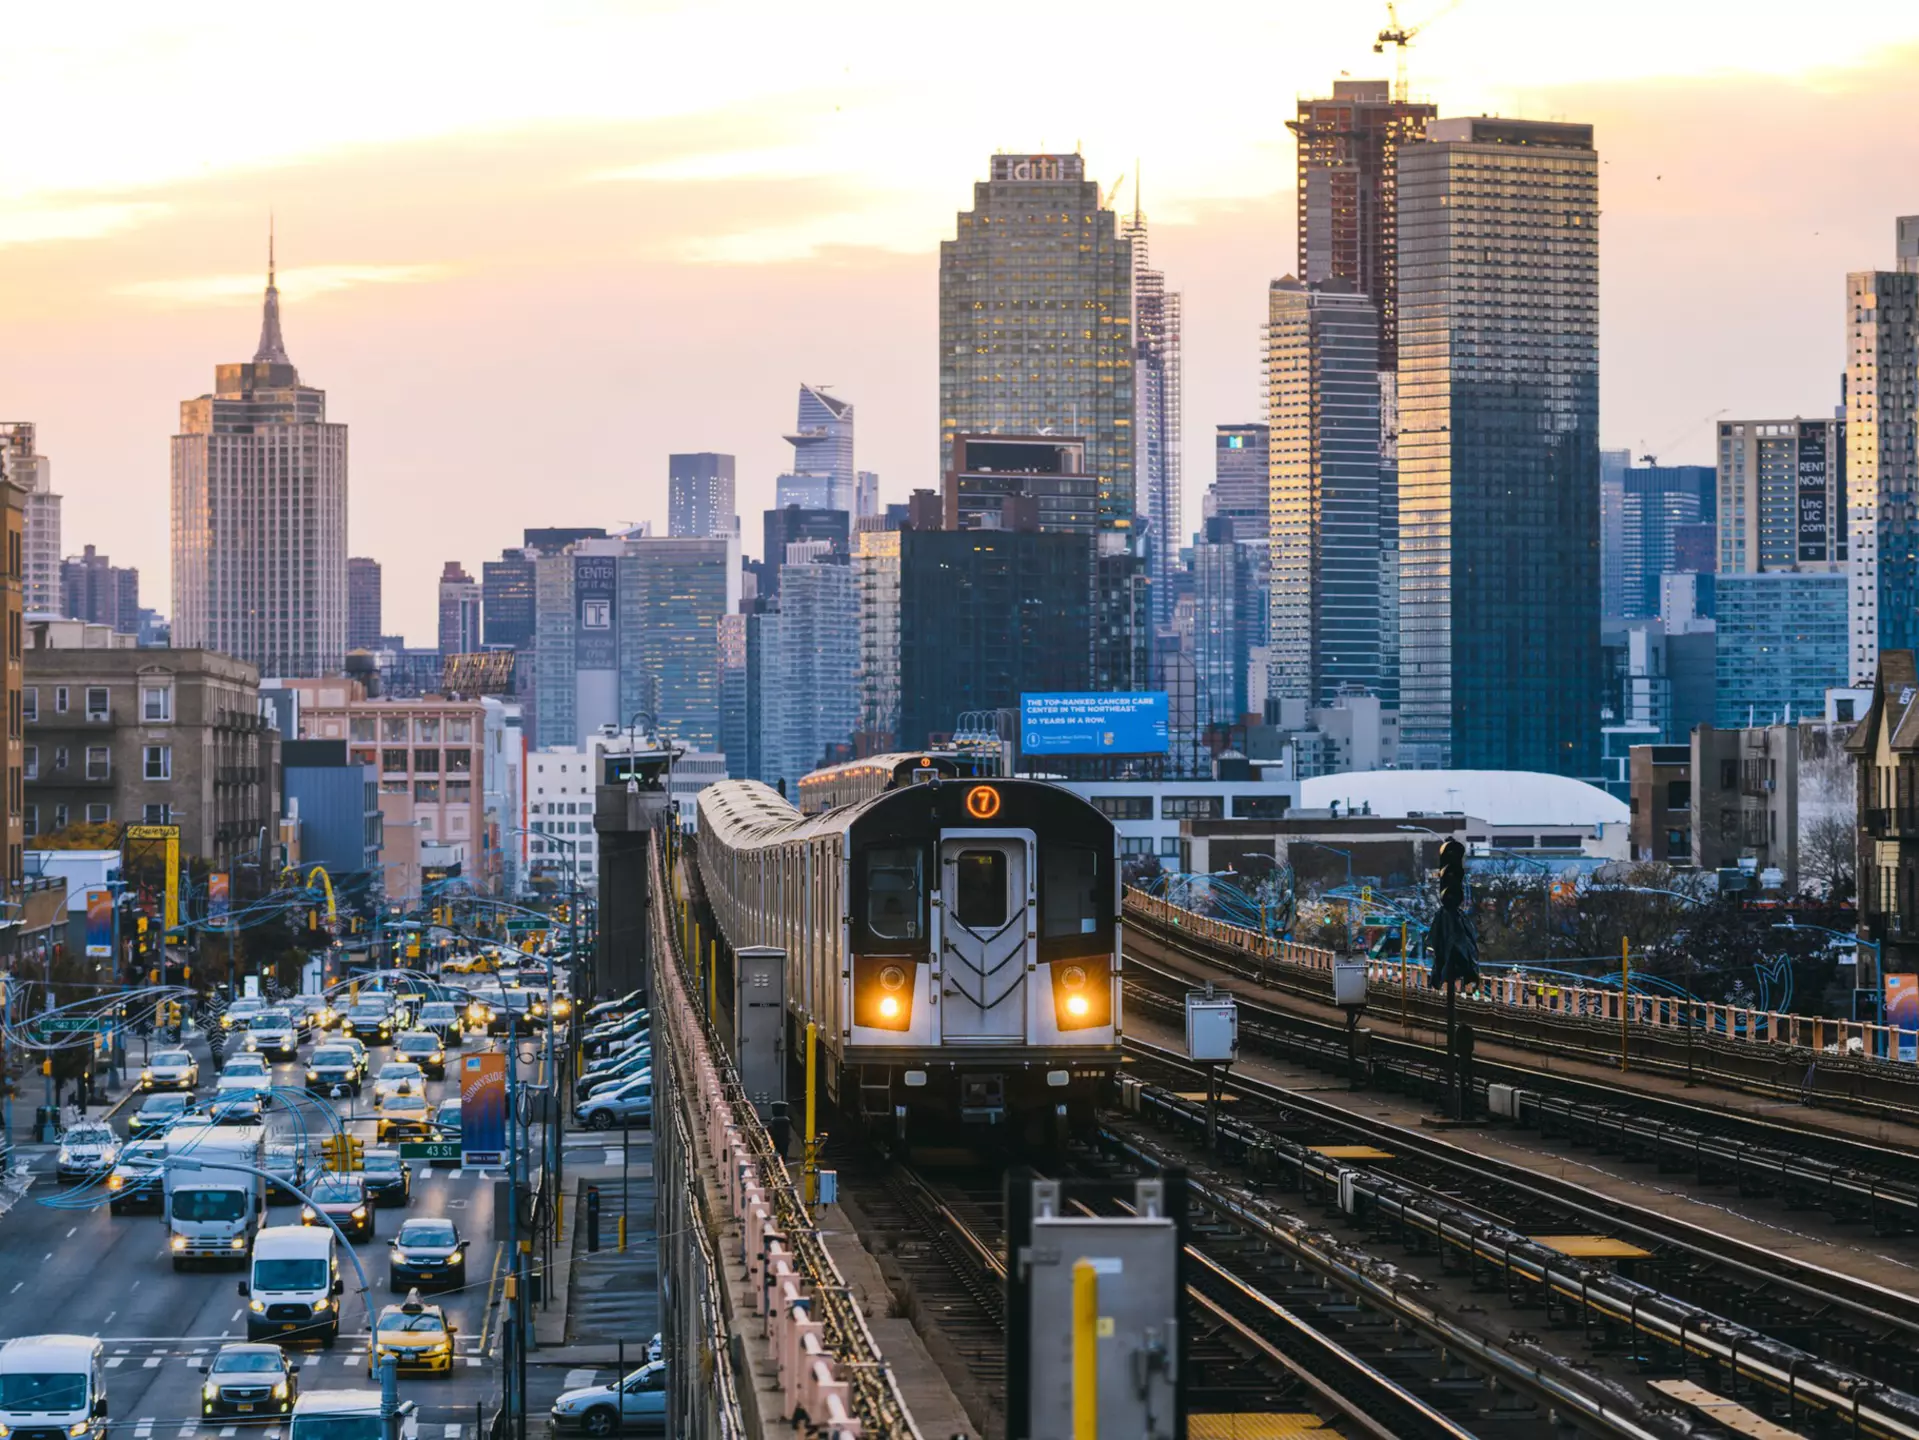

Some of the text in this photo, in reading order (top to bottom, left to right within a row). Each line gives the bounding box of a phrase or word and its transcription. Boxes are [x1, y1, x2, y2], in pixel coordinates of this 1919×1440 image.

[1799, 462, 1825, 472] RENT
[1799, 475, 1825, 486] NOW
[1800, 498, 1824, 509] Linc
[1803, 511, 1821, 521] LIC
[1798, 524, 1826, 533] .com
[578, 567, 614, 579] CENTER
[977, 792, 990, 812] 7
[462, 1071, 504, 1103] SUNNYSIDE
[426, 1145, 452, 1156] 43 St
